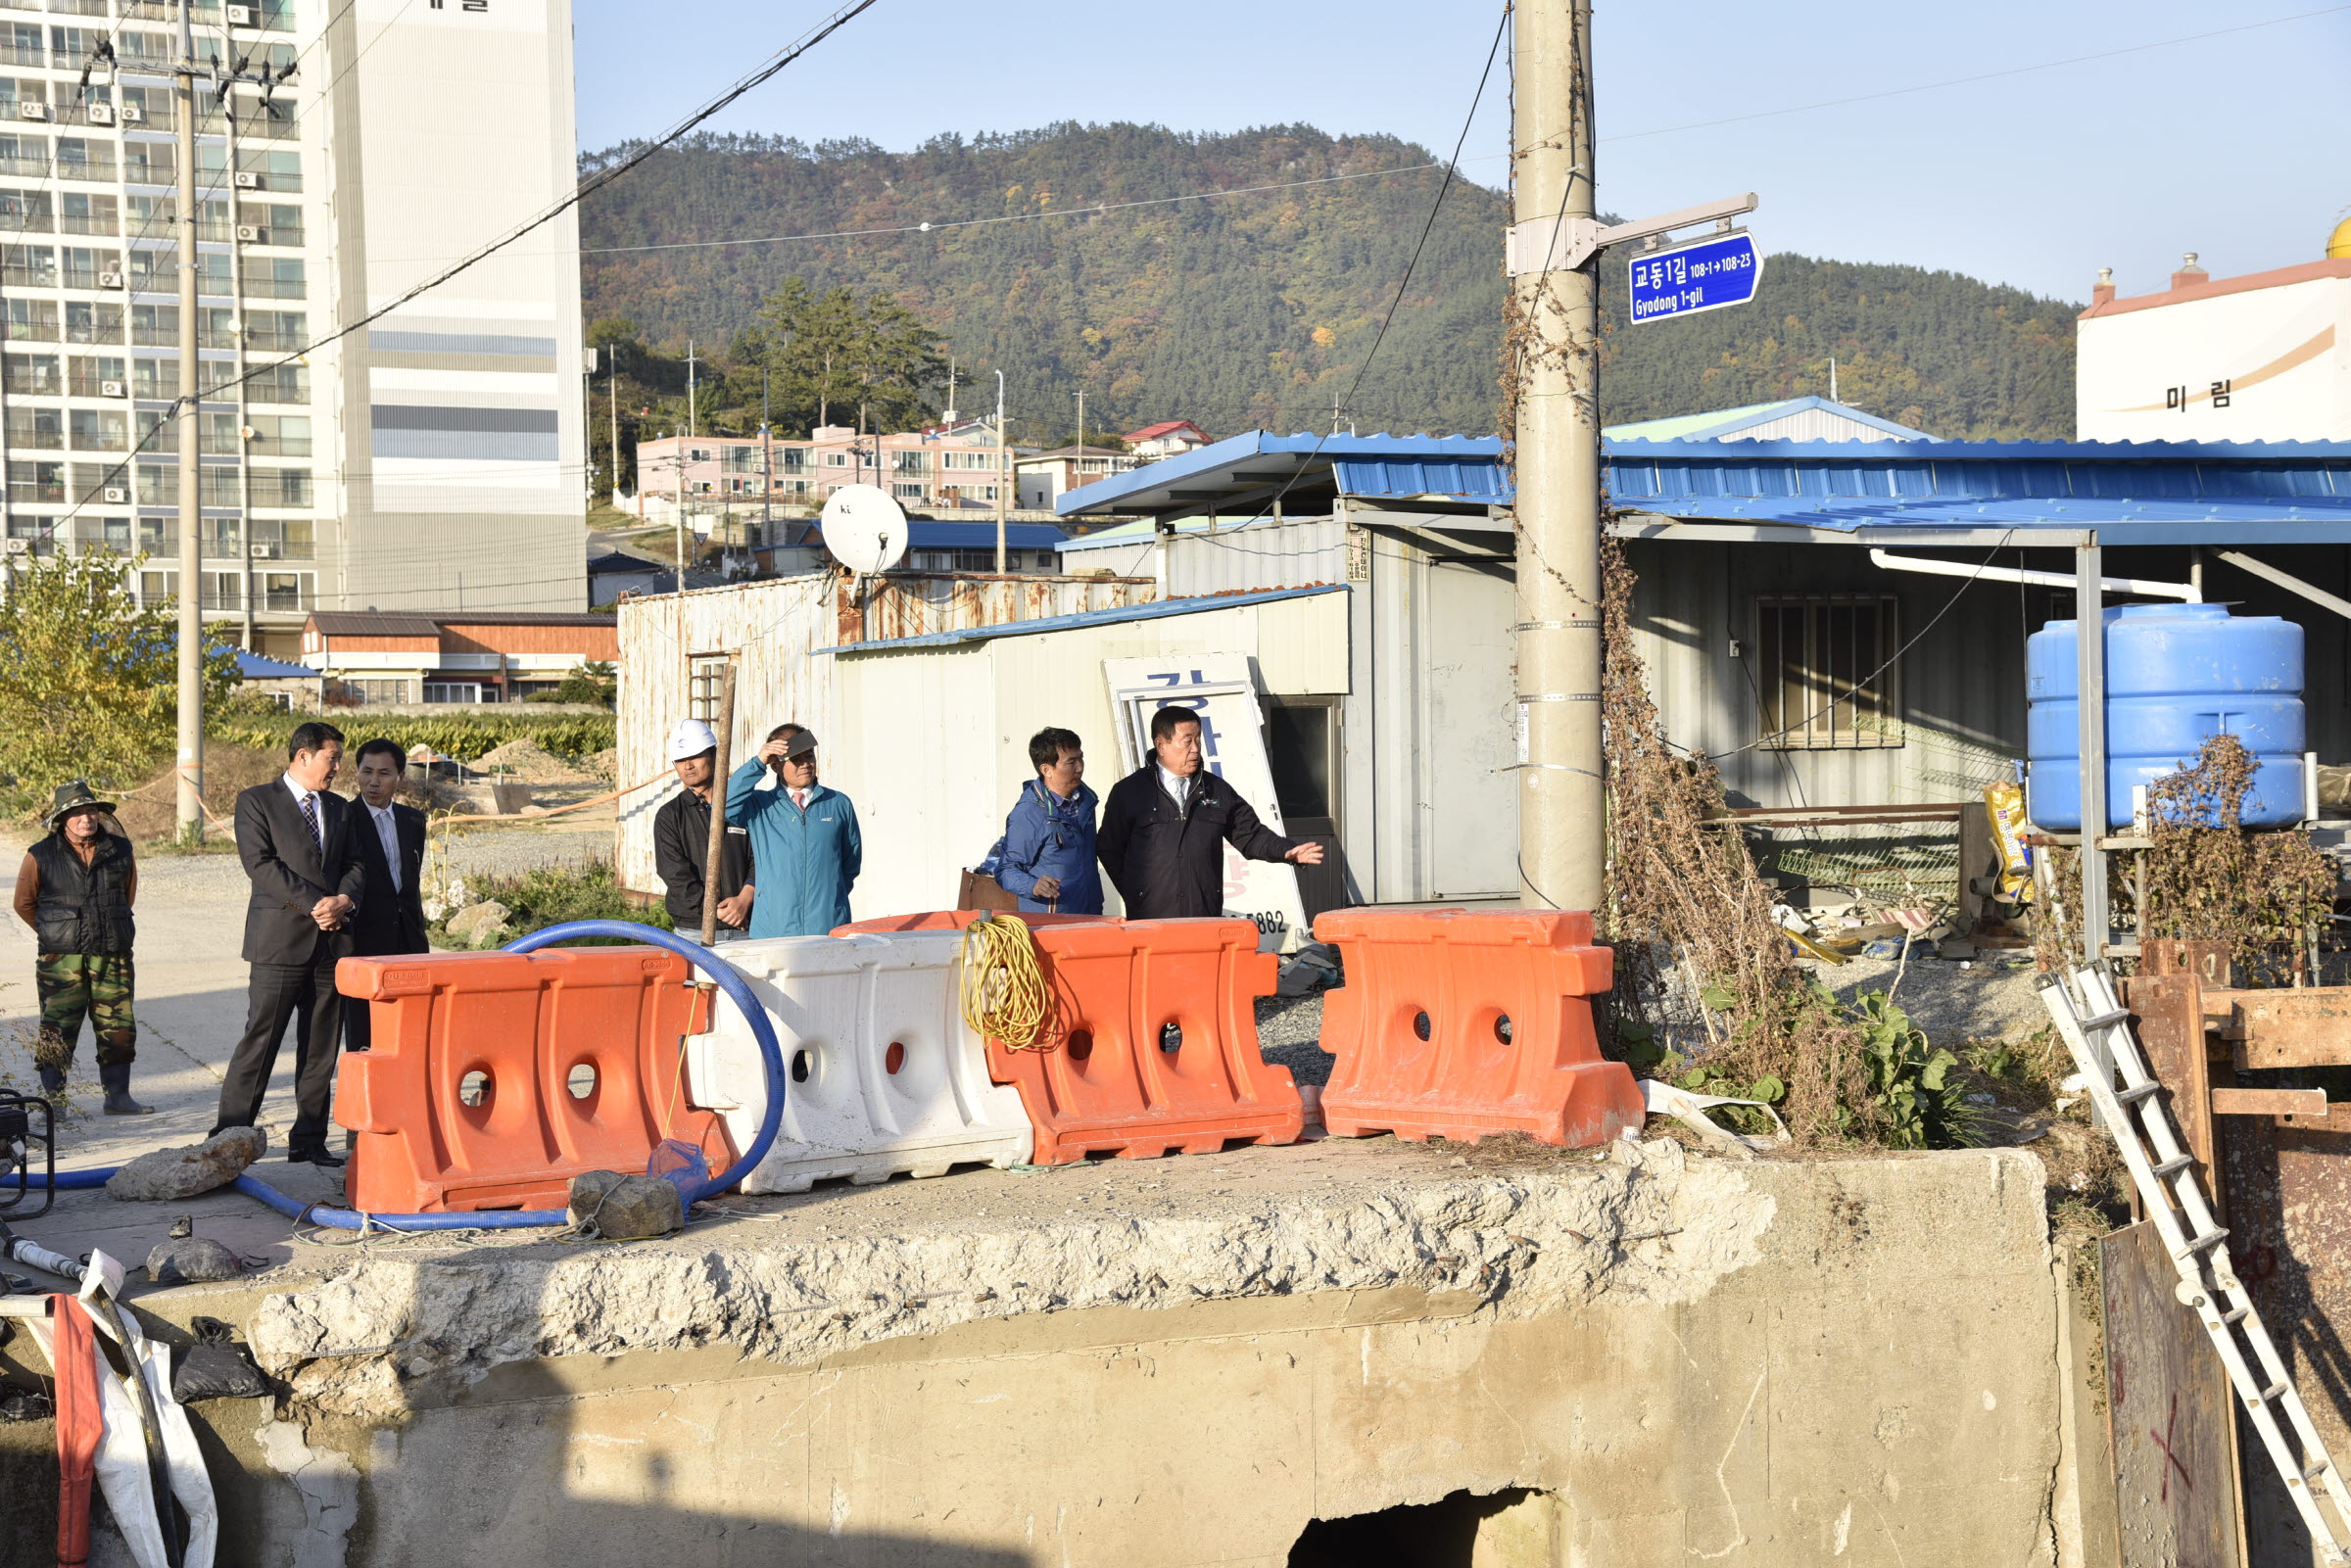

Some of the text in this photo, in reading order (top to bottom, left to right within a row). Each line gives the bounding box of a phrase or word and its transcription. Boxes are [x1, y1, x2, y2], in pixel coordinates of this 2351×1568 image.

[1635, 253, 1751, 290] 교동1길 108-1 108-23
[1636, 286, 1703, 317] Gyodong 1-gil
[1247, 911, 1286, 935] 882
